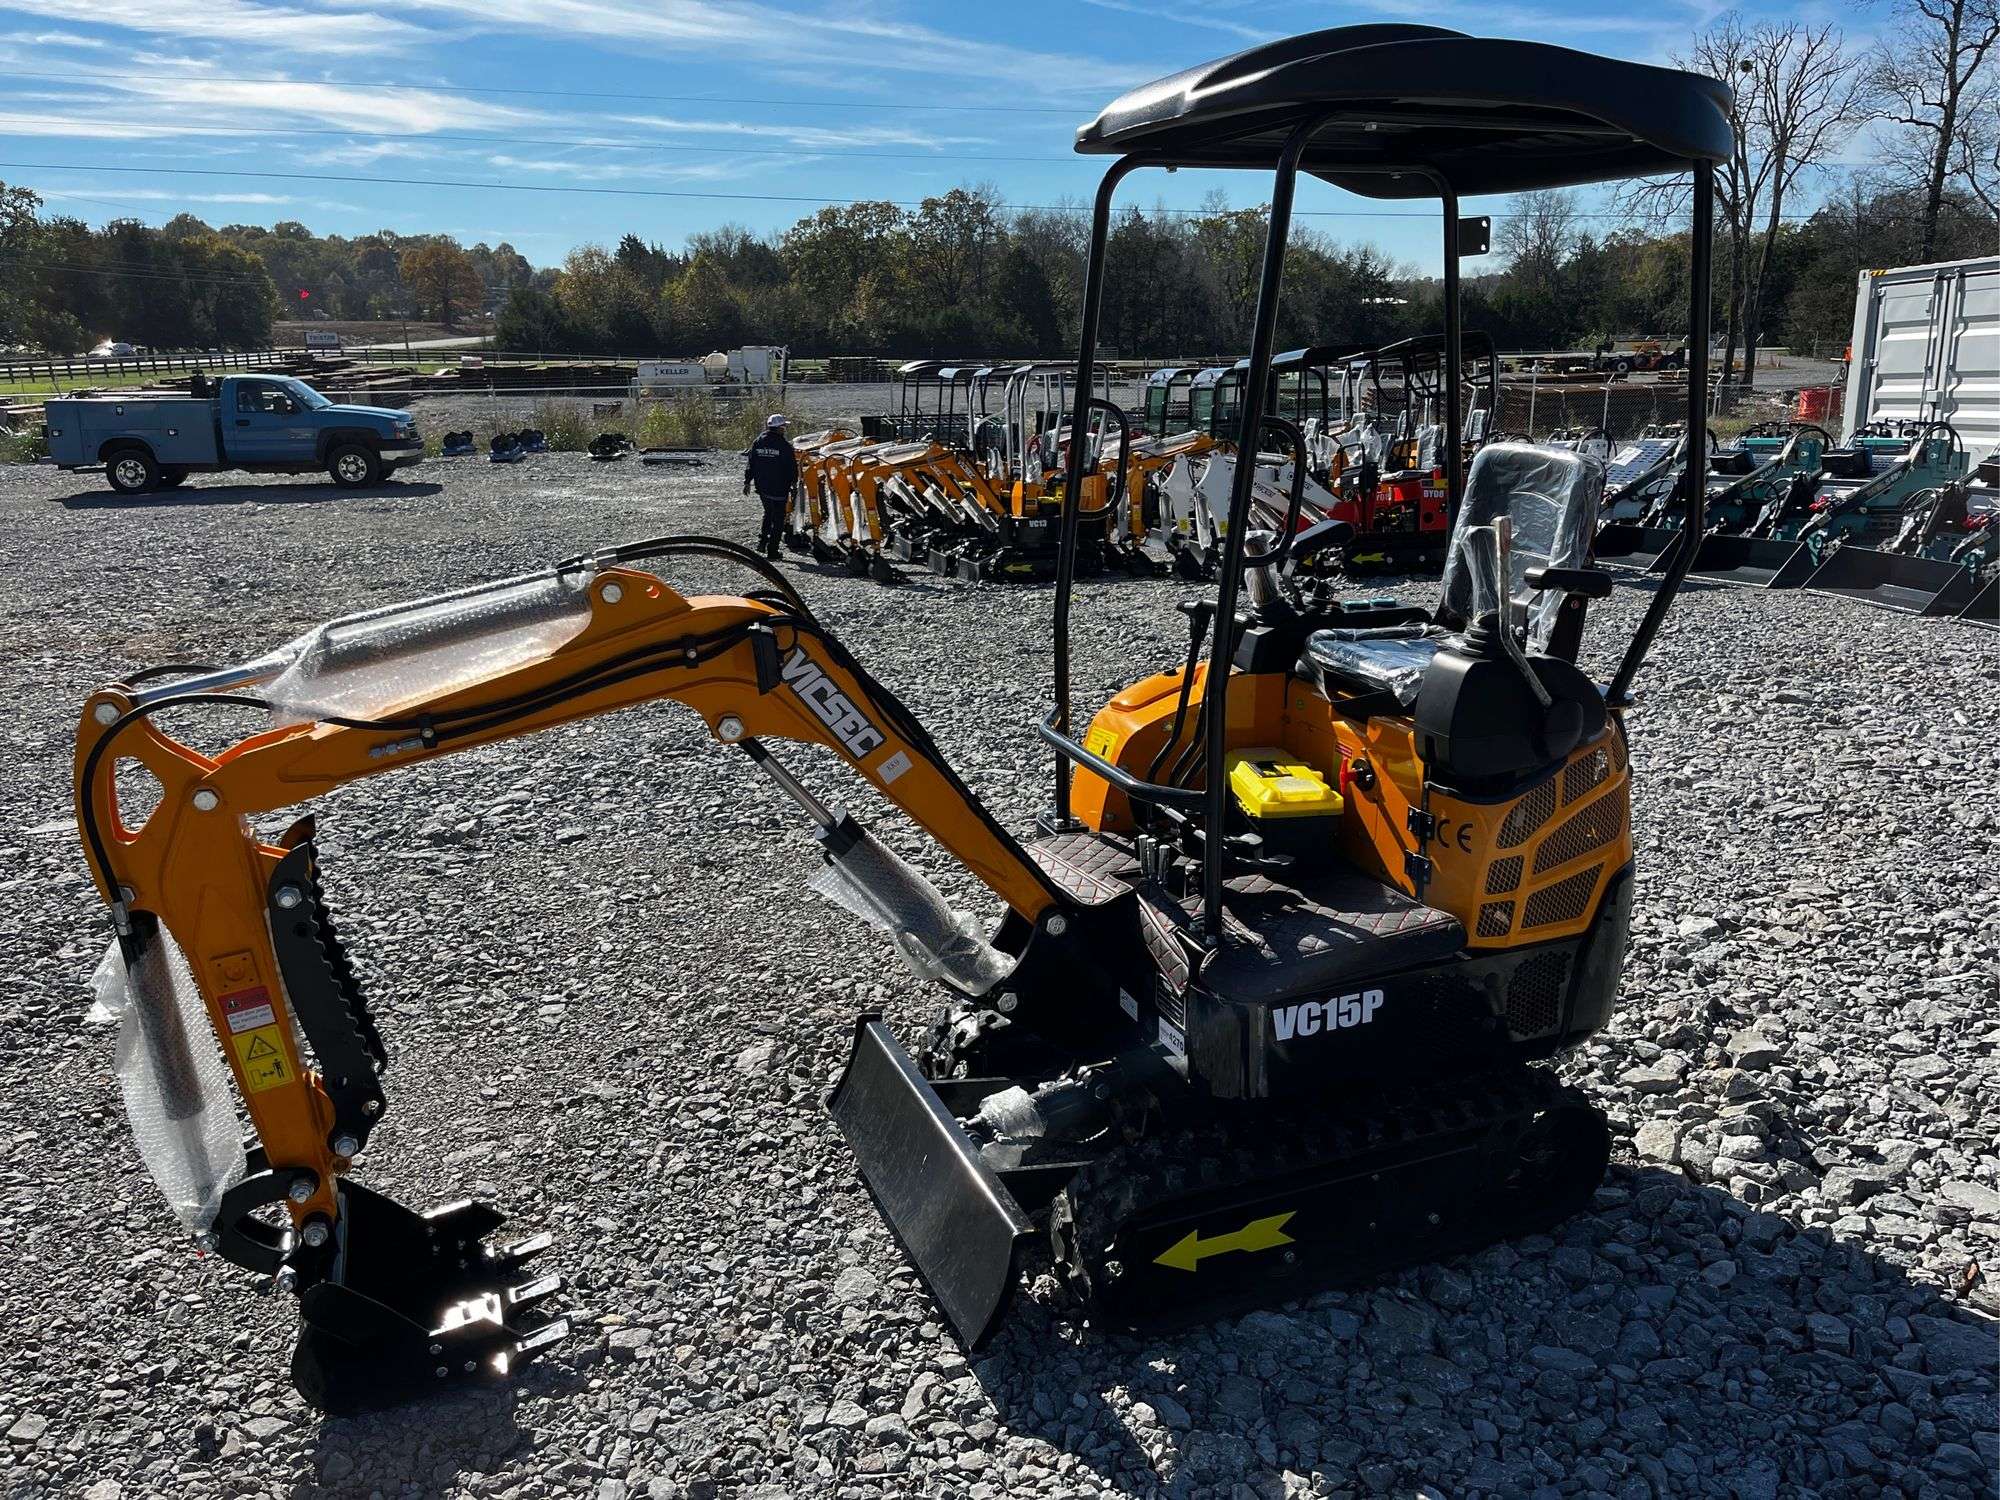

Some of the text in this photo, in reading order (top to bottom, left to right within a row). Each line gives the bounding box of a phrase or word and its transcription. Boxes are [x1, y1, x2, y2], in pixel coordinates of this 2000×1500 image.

[782, 647, 884, 759] VICSEC
[1437, 818, 1474, 854] CE
[1272, 989, 1384, 1041] VC15P
